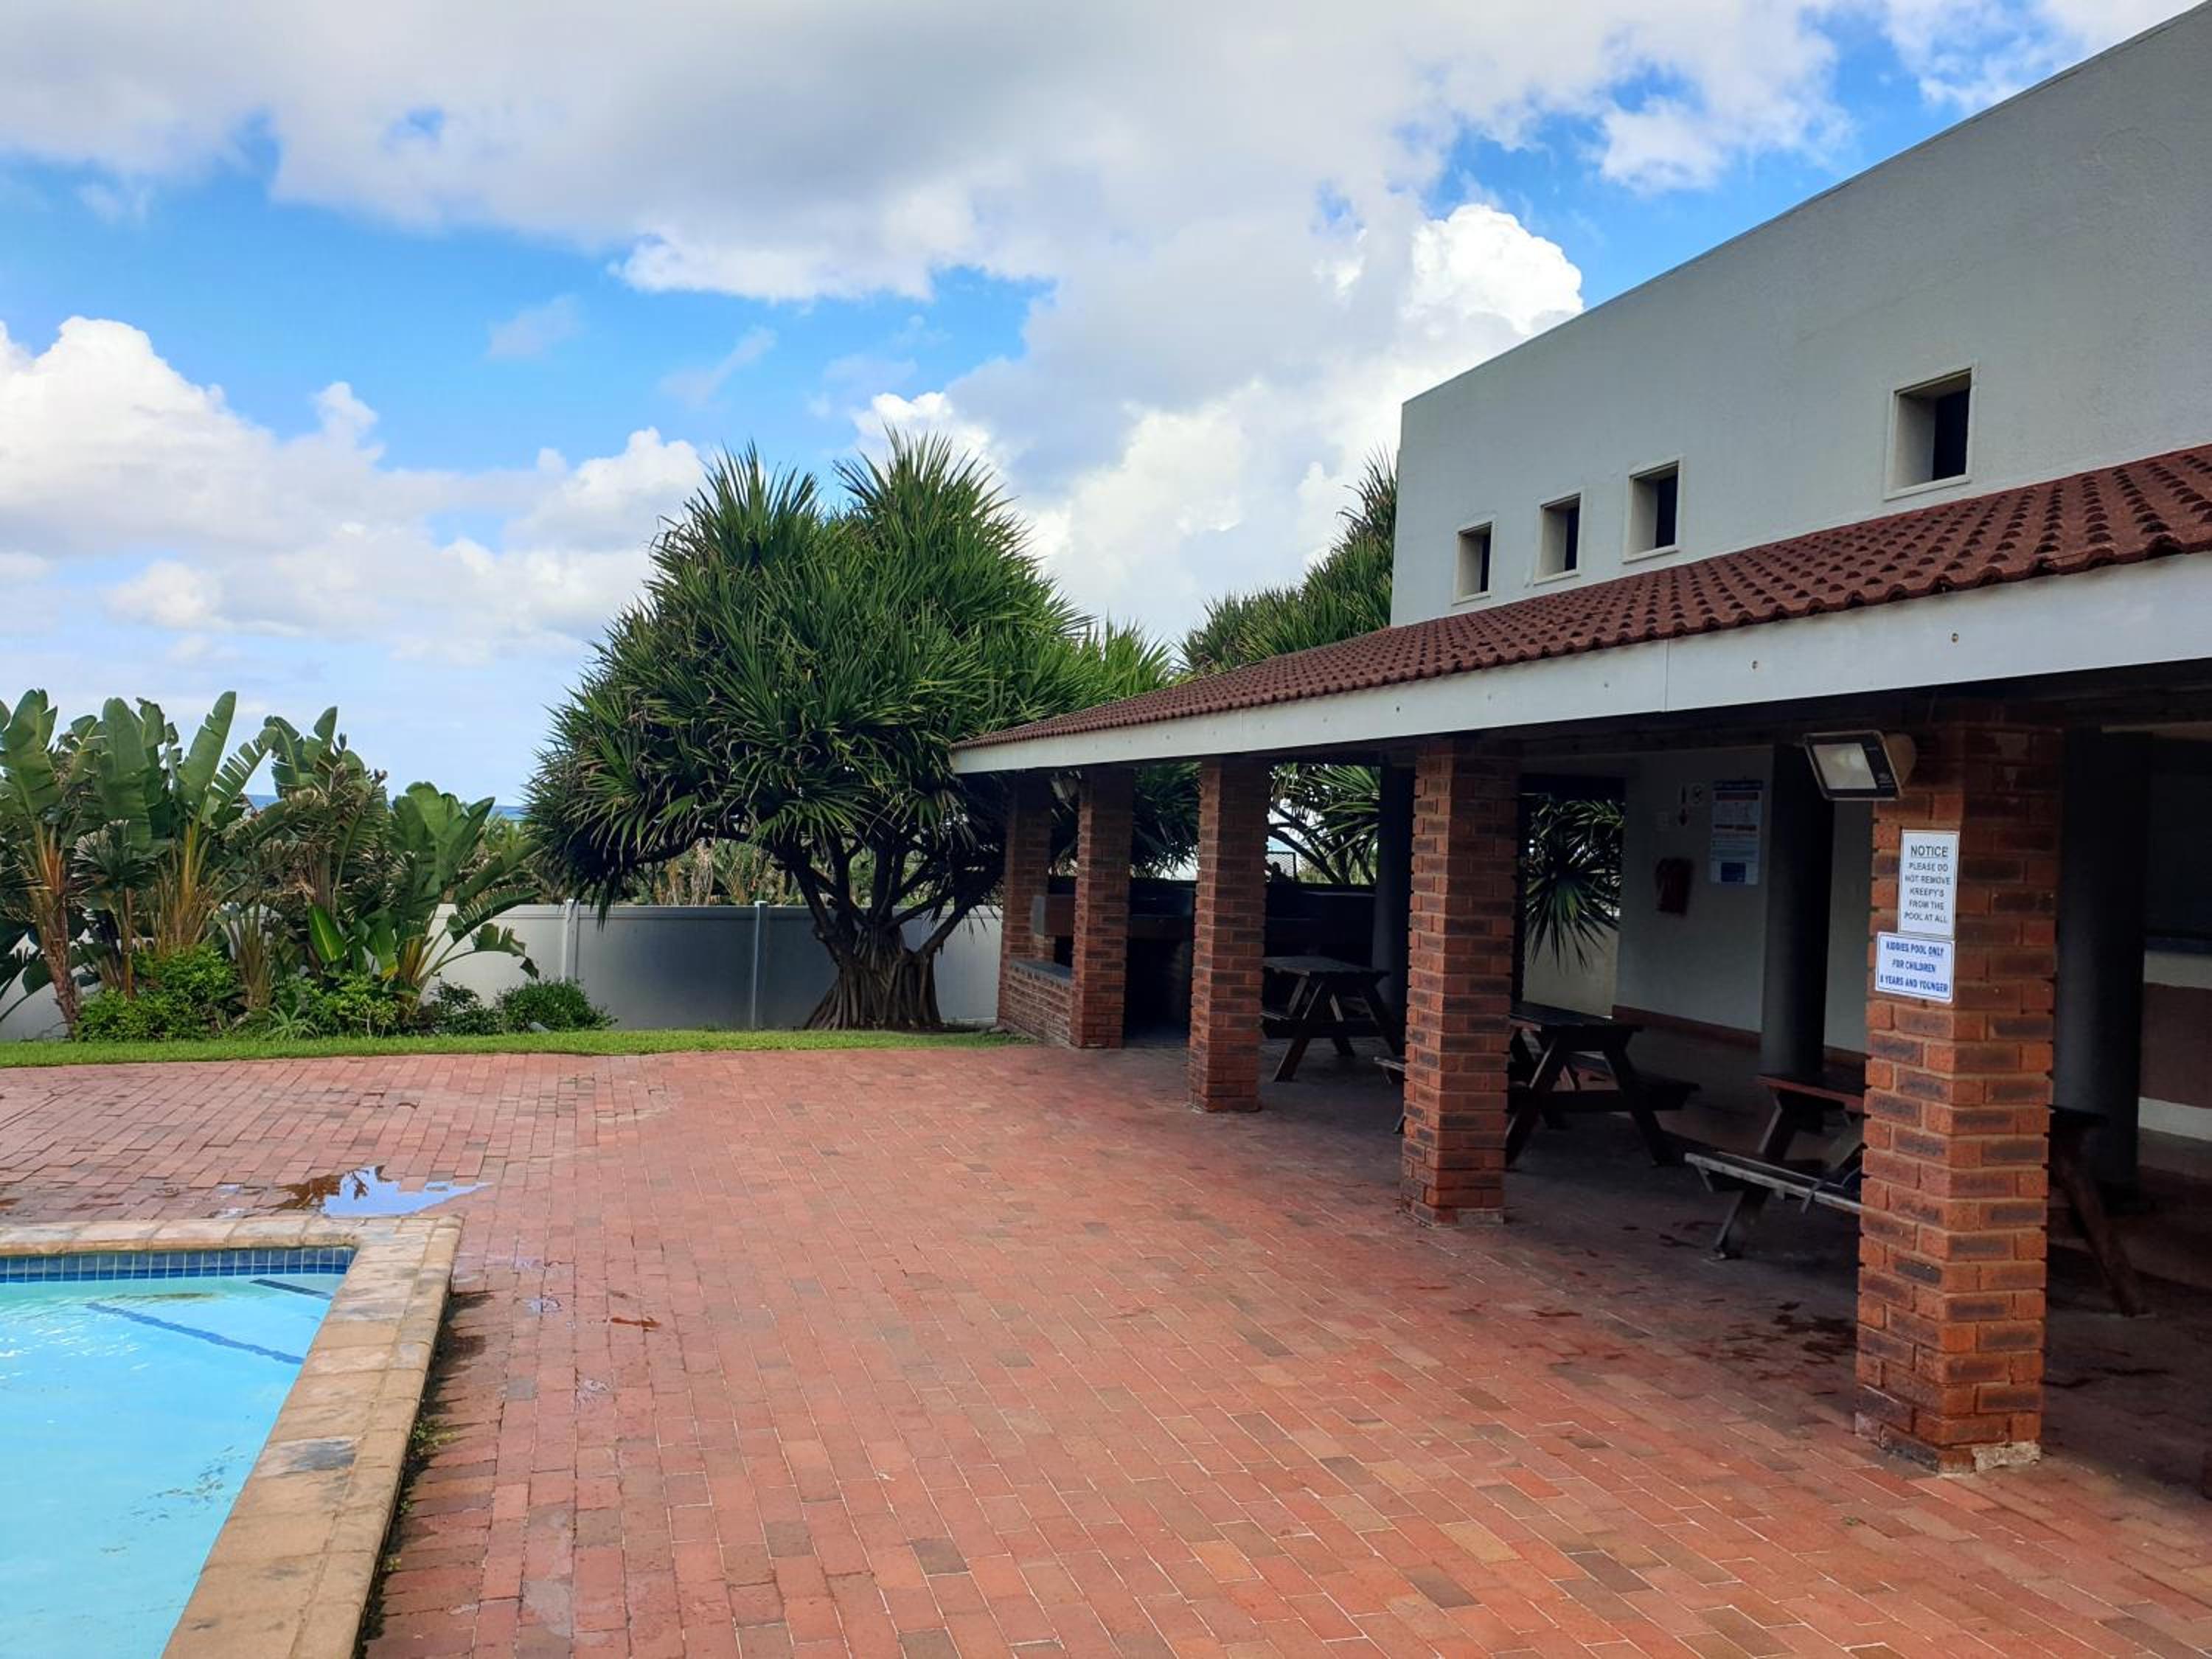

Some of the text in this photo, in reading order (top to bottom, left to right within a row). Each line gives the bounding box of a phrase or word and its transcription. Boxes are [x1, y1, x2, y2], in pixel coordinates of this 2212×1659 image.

[1910, 845, 1948, 857] NOTICE
[1909, 863, 1948, 872] PLEASE DO
[1921, 876, 1951, 885] REMOVE
[1909, 900, 1944, 910] FROM THE
[1905, 911, 1923, 921] POOL
[1935, 915, 1947, 923] ALL
[1886, 941, 1944, 956] KIDDIES POOL ONLY
[1892, 959, 1935, 973] FOR CHILDREN
[1885, 975, 1904, 985] YEARS
[1905, 978, 1918, 988] AND
[1919, 980, 1948, 992] YOUNGER
